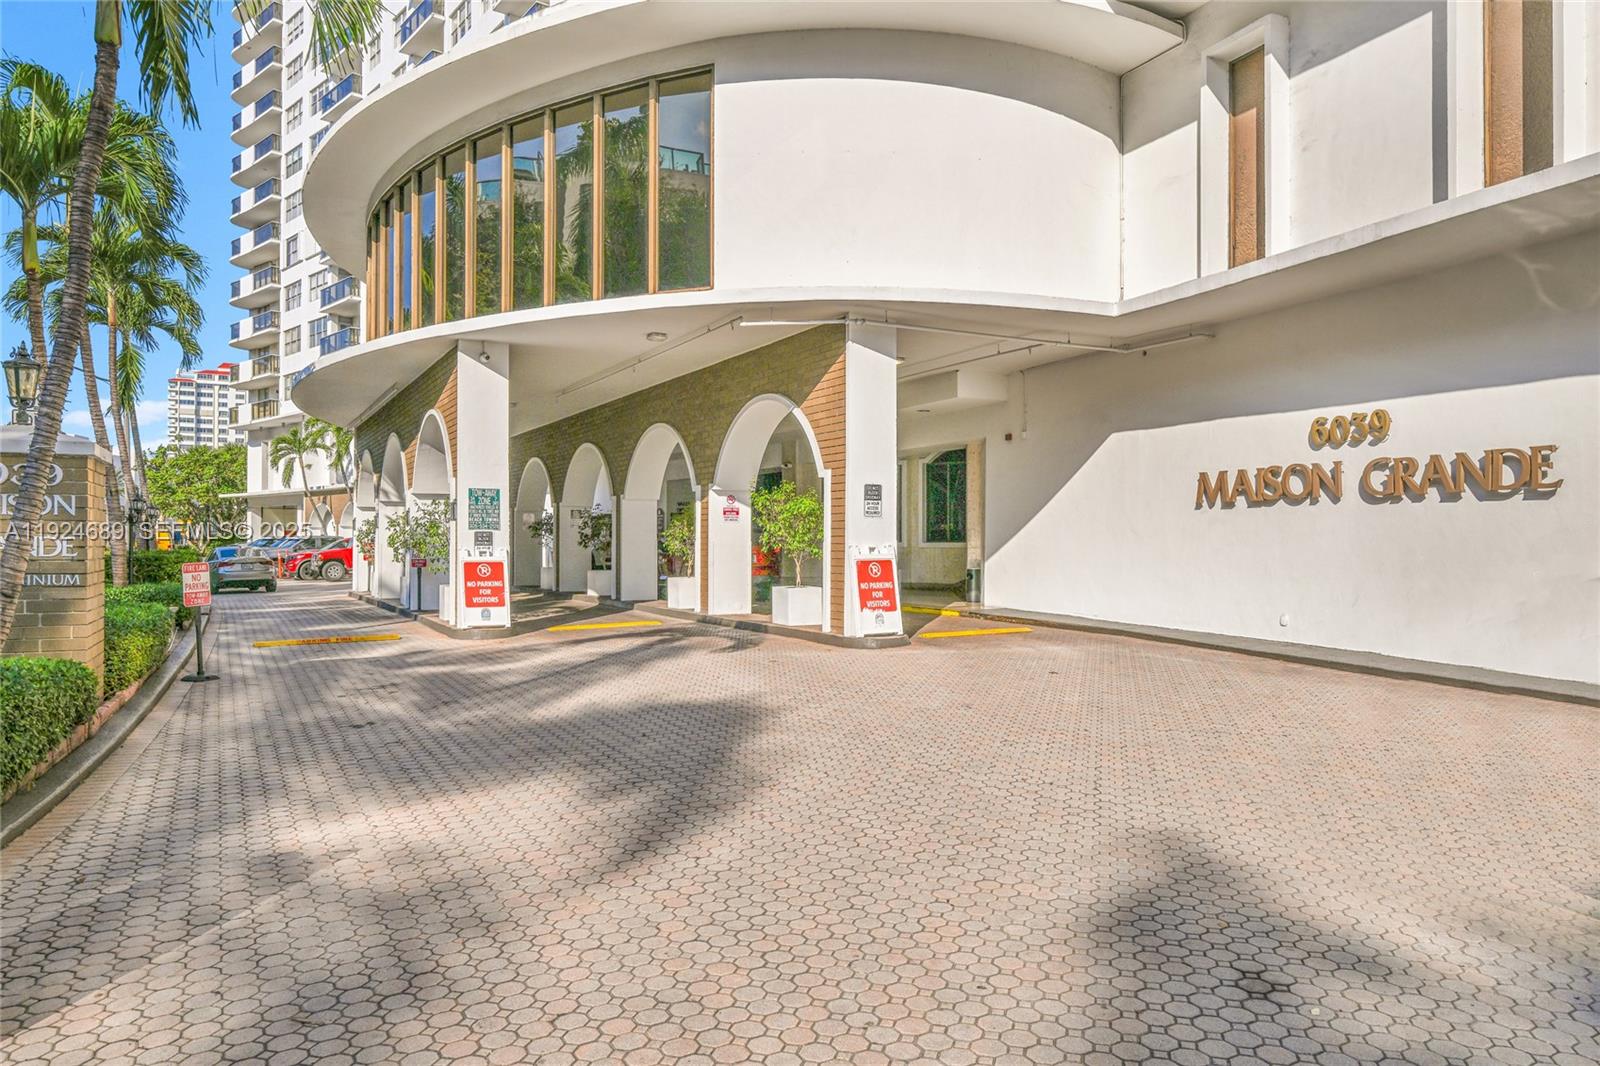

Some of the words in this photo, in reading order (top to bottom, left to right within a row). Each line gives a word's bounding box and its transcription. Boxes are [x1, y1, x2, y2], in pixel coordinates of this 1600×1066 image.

[1309, 408, 1391, 448] 6039
[1195, 460, 1344, 509] MAISON
[1361, 444, 1563, 501] GRANDE
[22, 574, 81, 586] INIUM
[191, 574, 201, 582] NO
[185, 582, 209, 592] PARKING
[870, 581, 893, 589] PARKING
